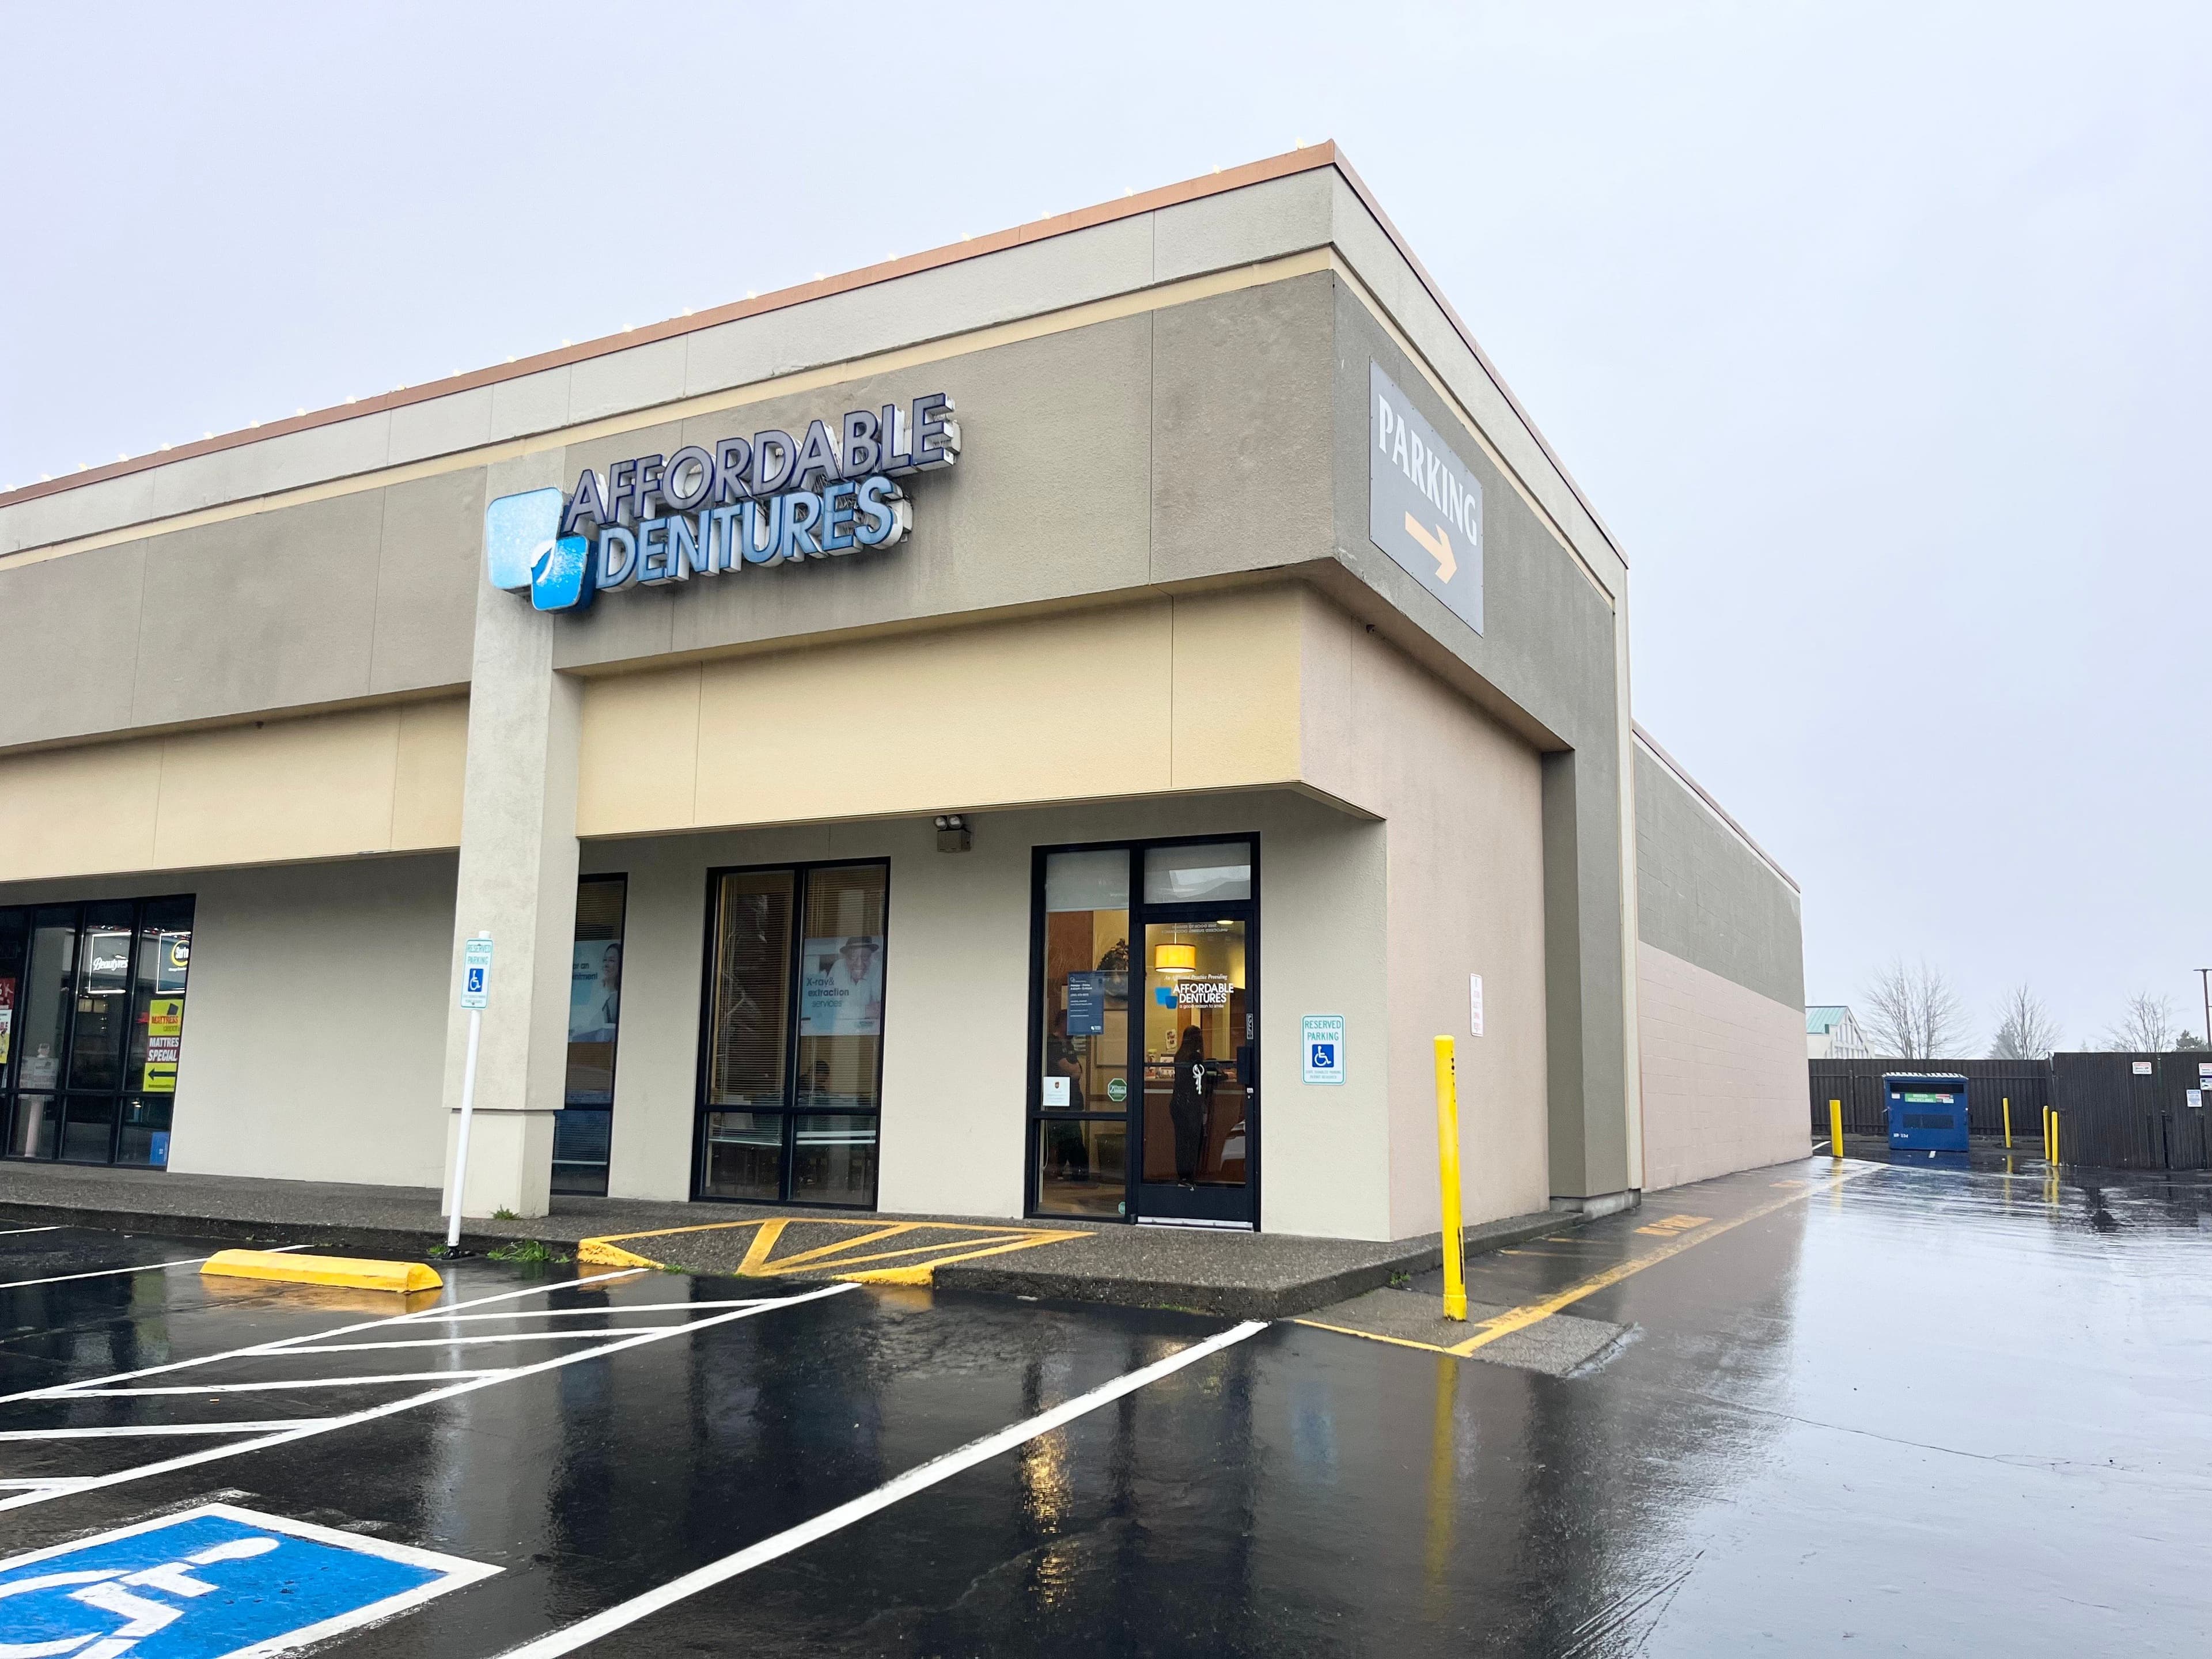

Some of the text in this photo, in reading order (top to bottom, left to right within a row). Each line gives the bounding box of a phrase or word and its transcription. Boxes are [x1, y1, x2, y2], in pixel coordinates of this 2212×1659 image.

[563, 392, 953, 534] AFFORDABLE
[1378, 393, 1477, 546] PARKING
[596, 476, 900, 591] DENTURES
[467, 945, 491, 953] RESERVED
[468, 956, 489, 965] PARKING
[808, 988, 849, 997] extraction
[1173, 983, 1234, 994] AFFORDABLE
[1179, 993, 1227, 1003] DENTURES
[151, 1016, 179, 1024] MATTRESS
[1305, 1020, 1341, 1029] RESERVED
[1307, 1032, 1339, 1041] PARKING
[149, 1037, 179, 1048] MATTRES
[147, 1049, 178, 1062] SPECIAL
